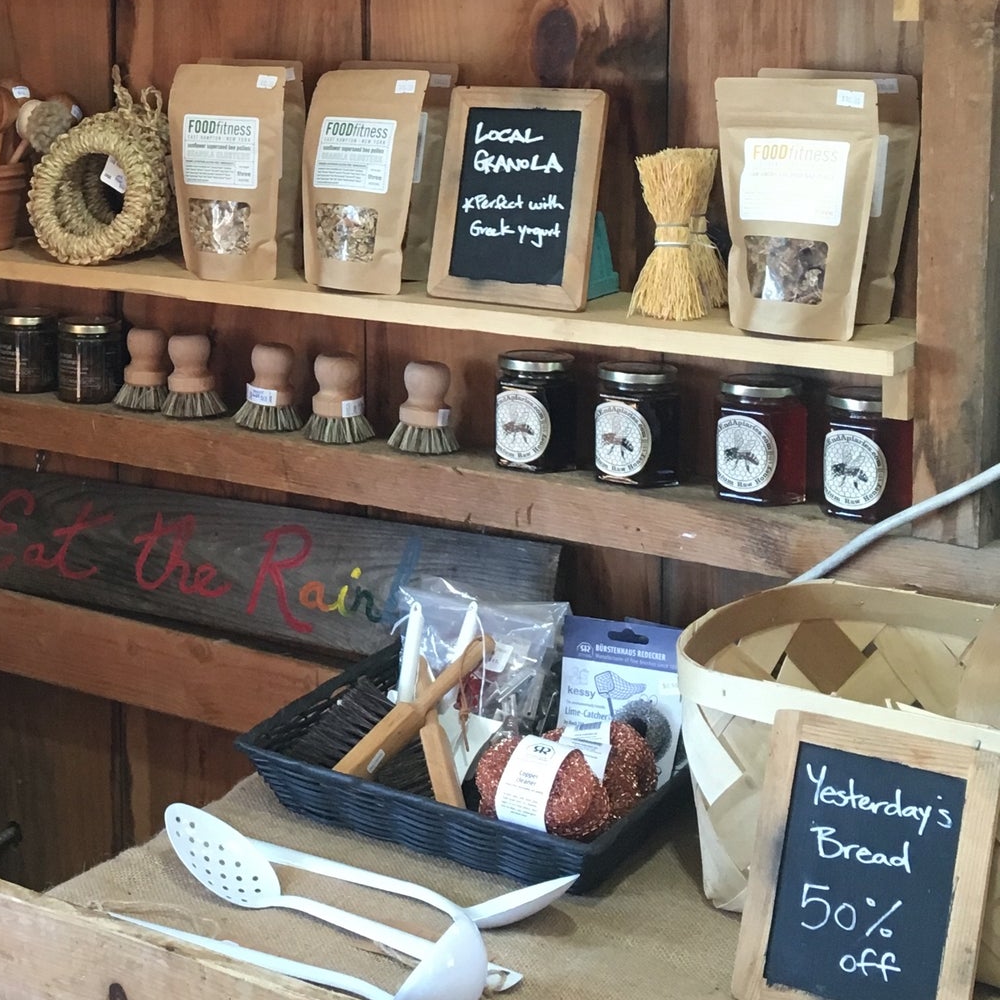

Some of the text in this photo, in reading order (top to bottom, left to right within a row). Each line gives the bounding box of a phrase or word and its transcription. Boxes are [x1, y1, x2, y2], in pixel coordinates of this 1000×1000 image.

[188, 119, 252, 137] FOODfitness
[325, 121, 389, 139] FOODfitness
[474, 121, 544, 145] LOCAL
[473, 149, 564, 175] GRANOLA
[753, 144, 839, 163] FOODfitness
[528, 194, 564, 210] with
[470, 217, 561, 248] Greek yogurt
[133, 510, 232, 598] the
[595, 643, 666, 661] BÜRSTENHAUS REDECKER
[567, 685, 597, 699] kessy
[564, 705, 609, 720] Lime-Catcher
[806, 763, 953, 836] Yesterday's
[810, 826, 912, 874] Bread
[800, 883, 904, 939] 50%
[838, 948, 902, 983] off
